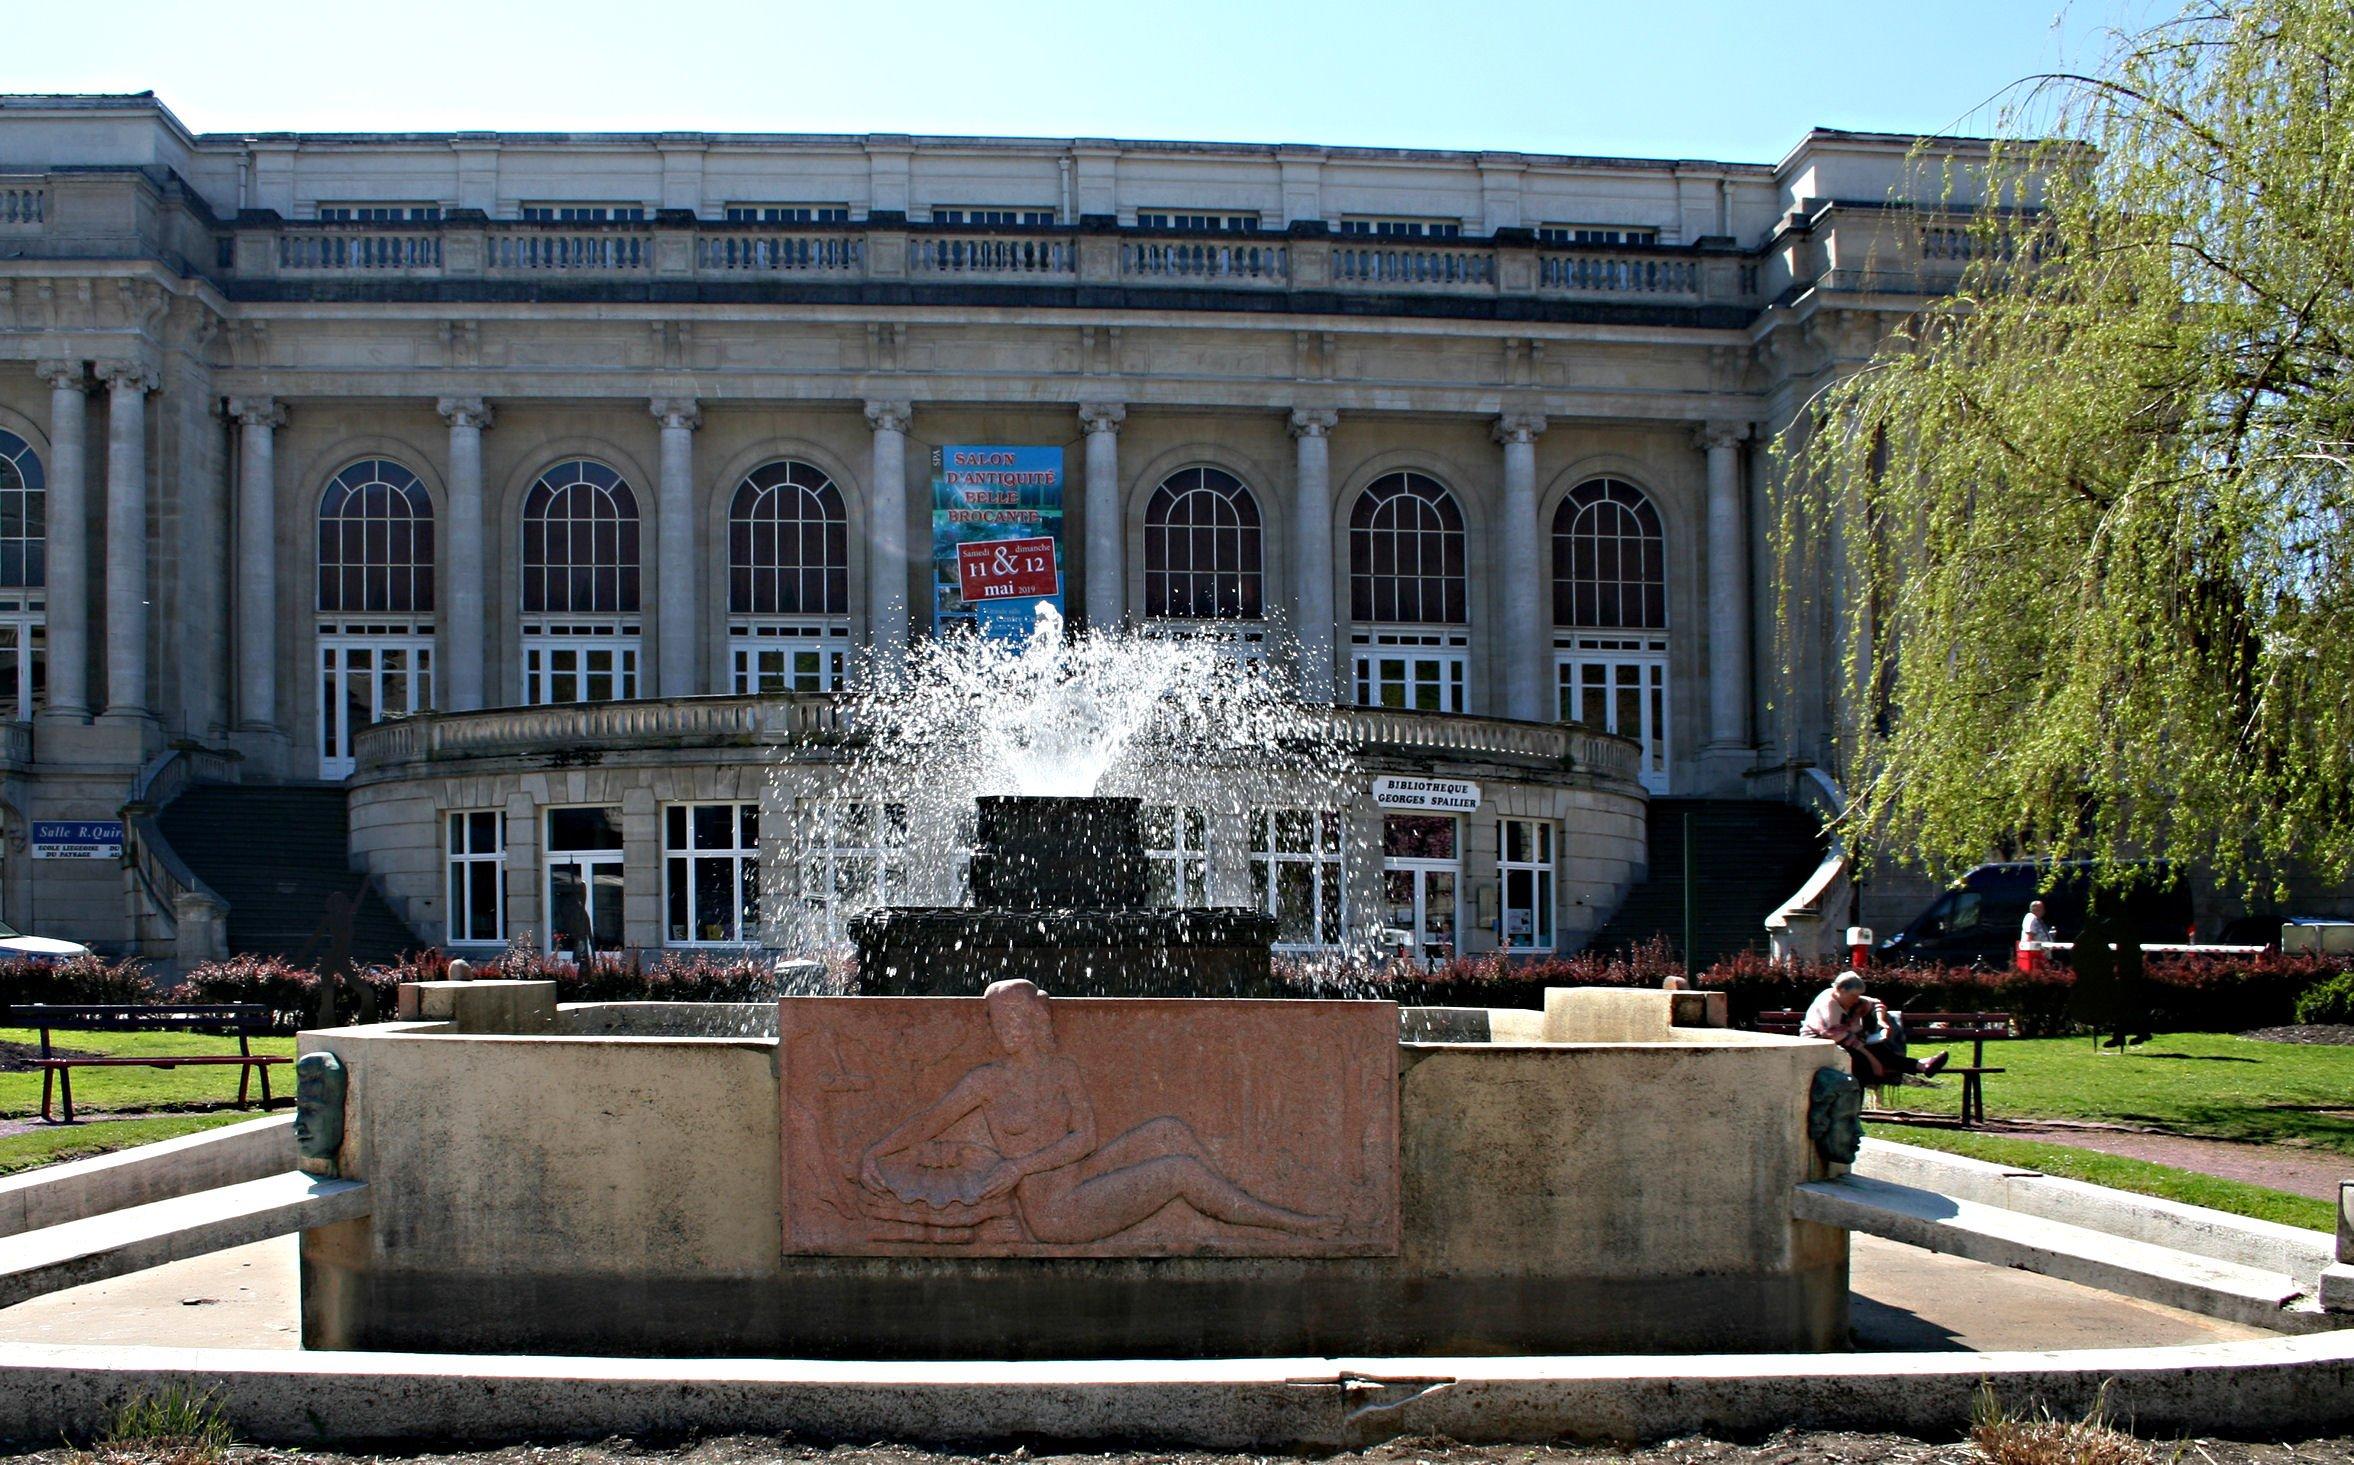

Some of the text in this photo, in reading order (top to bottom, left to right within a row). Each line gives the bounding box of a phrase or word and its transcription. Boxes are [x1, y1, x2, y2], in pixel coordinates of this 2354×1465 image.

[954, 452, 1016, 466] SALON
[946, 469, 1056, 488] D'ANTIQUITÉ
[964, 490, 1019, 505] BELLE
[948, 510, 1041, 524] BROCANTE
[1015, 543, 1051, 553] dimanche
[969, 546, 1045, 578] 11 & 12
[984, 580, 1036, 597] mai 2019
[1388, 780, 1468, 794] BIBLIOTHEQUE
[1378, 793, 1476, 808] GEORGES SPAILIER
[40, 826, 71, 838] Salle
